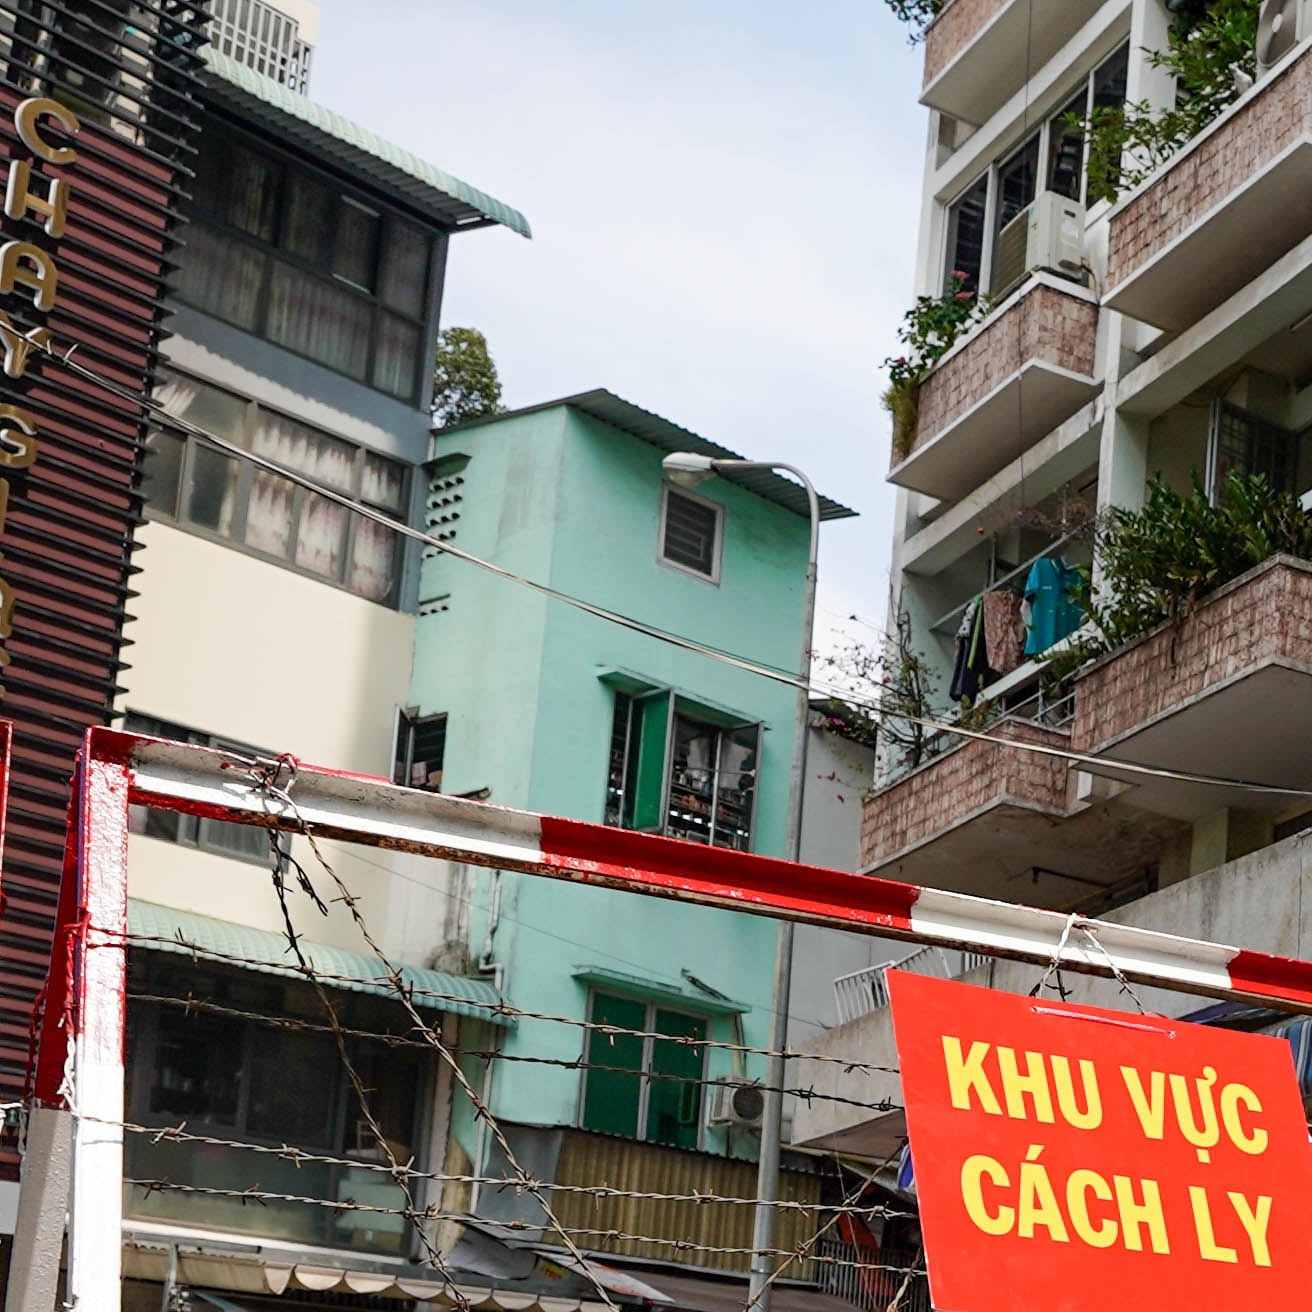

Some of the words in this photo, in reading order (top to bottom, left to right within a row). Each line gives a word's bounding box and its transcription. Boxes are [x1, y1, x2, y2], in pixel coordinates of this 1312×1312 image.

[942, 1035, 1103, 1131] KHU
[1119, 1066, 1269, 1164] VỰC
[960, 1144, 1171, 1256] CÁCH
[1188, 1186, 1273, 1268] LY
